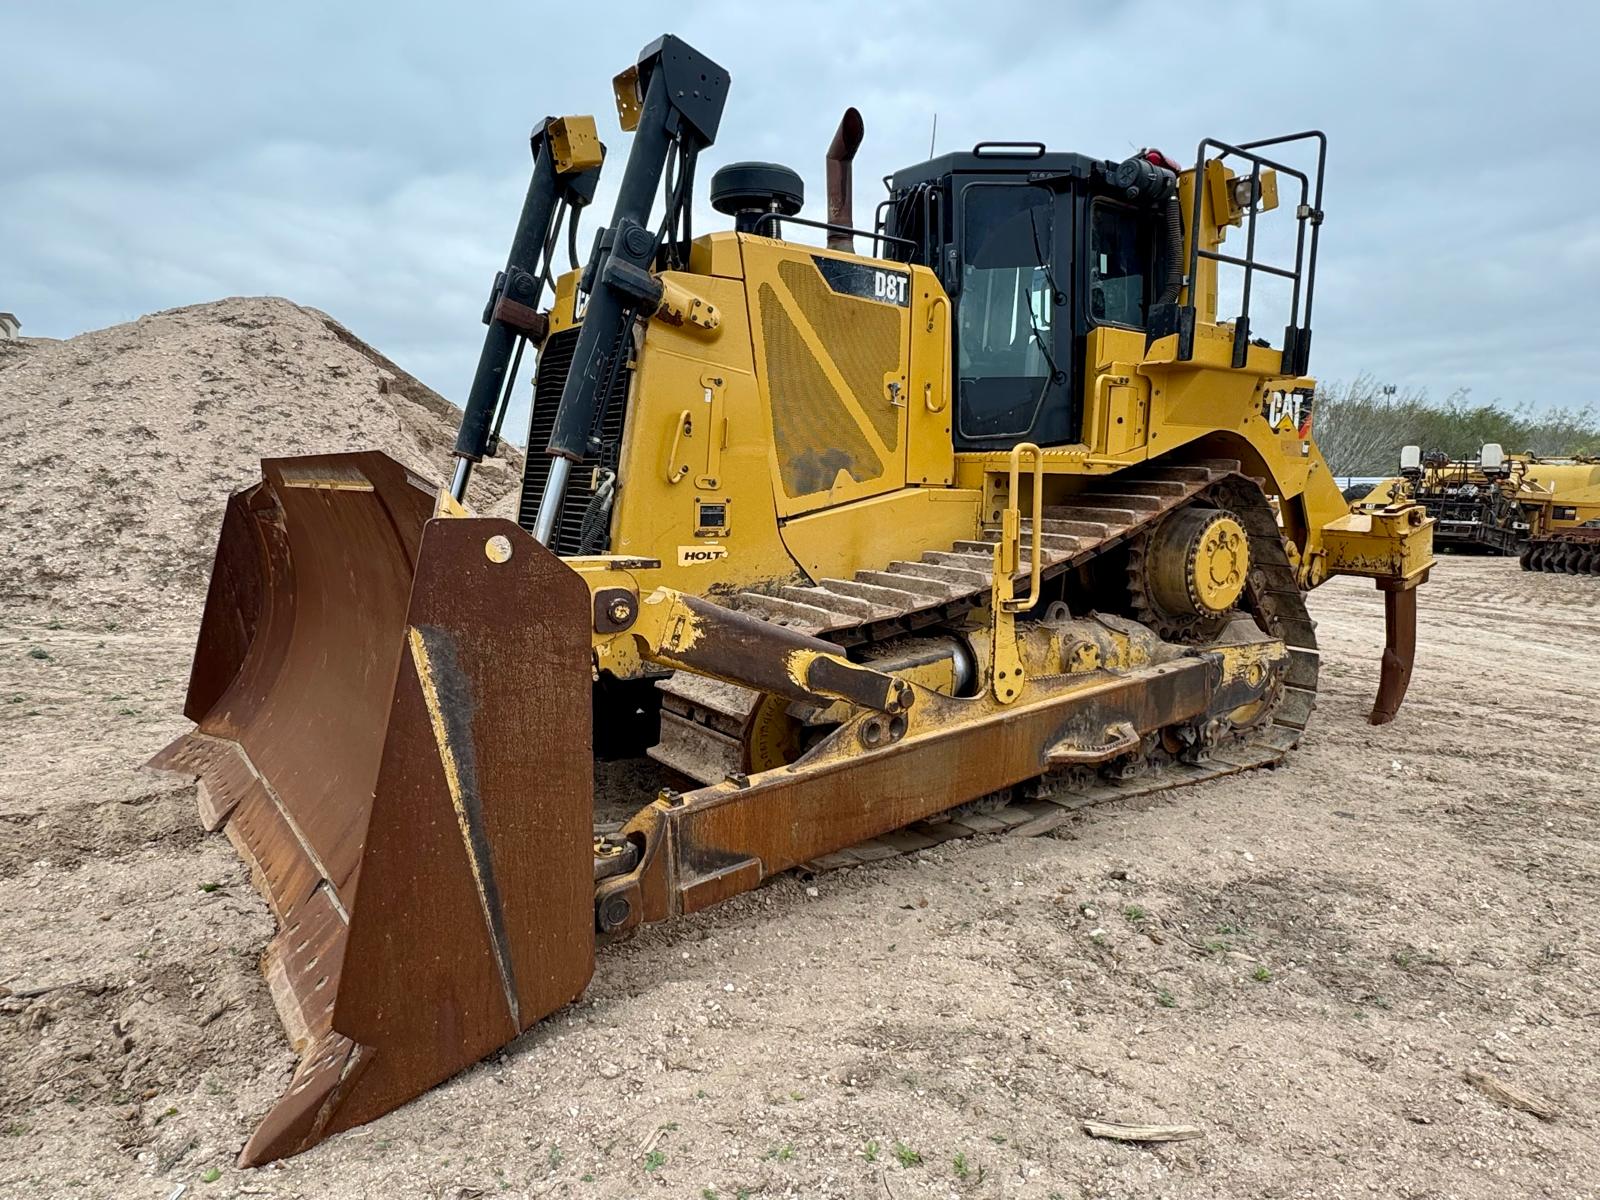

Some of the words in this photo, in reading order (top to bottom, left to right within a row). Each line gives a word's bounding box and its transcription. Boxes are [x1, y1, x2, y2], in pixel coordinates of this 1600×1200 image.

[874, 271, 908, 303] D8T
[1268, 391, 1304, 432] CAT
[684, 551, 723, 561] HOLT
